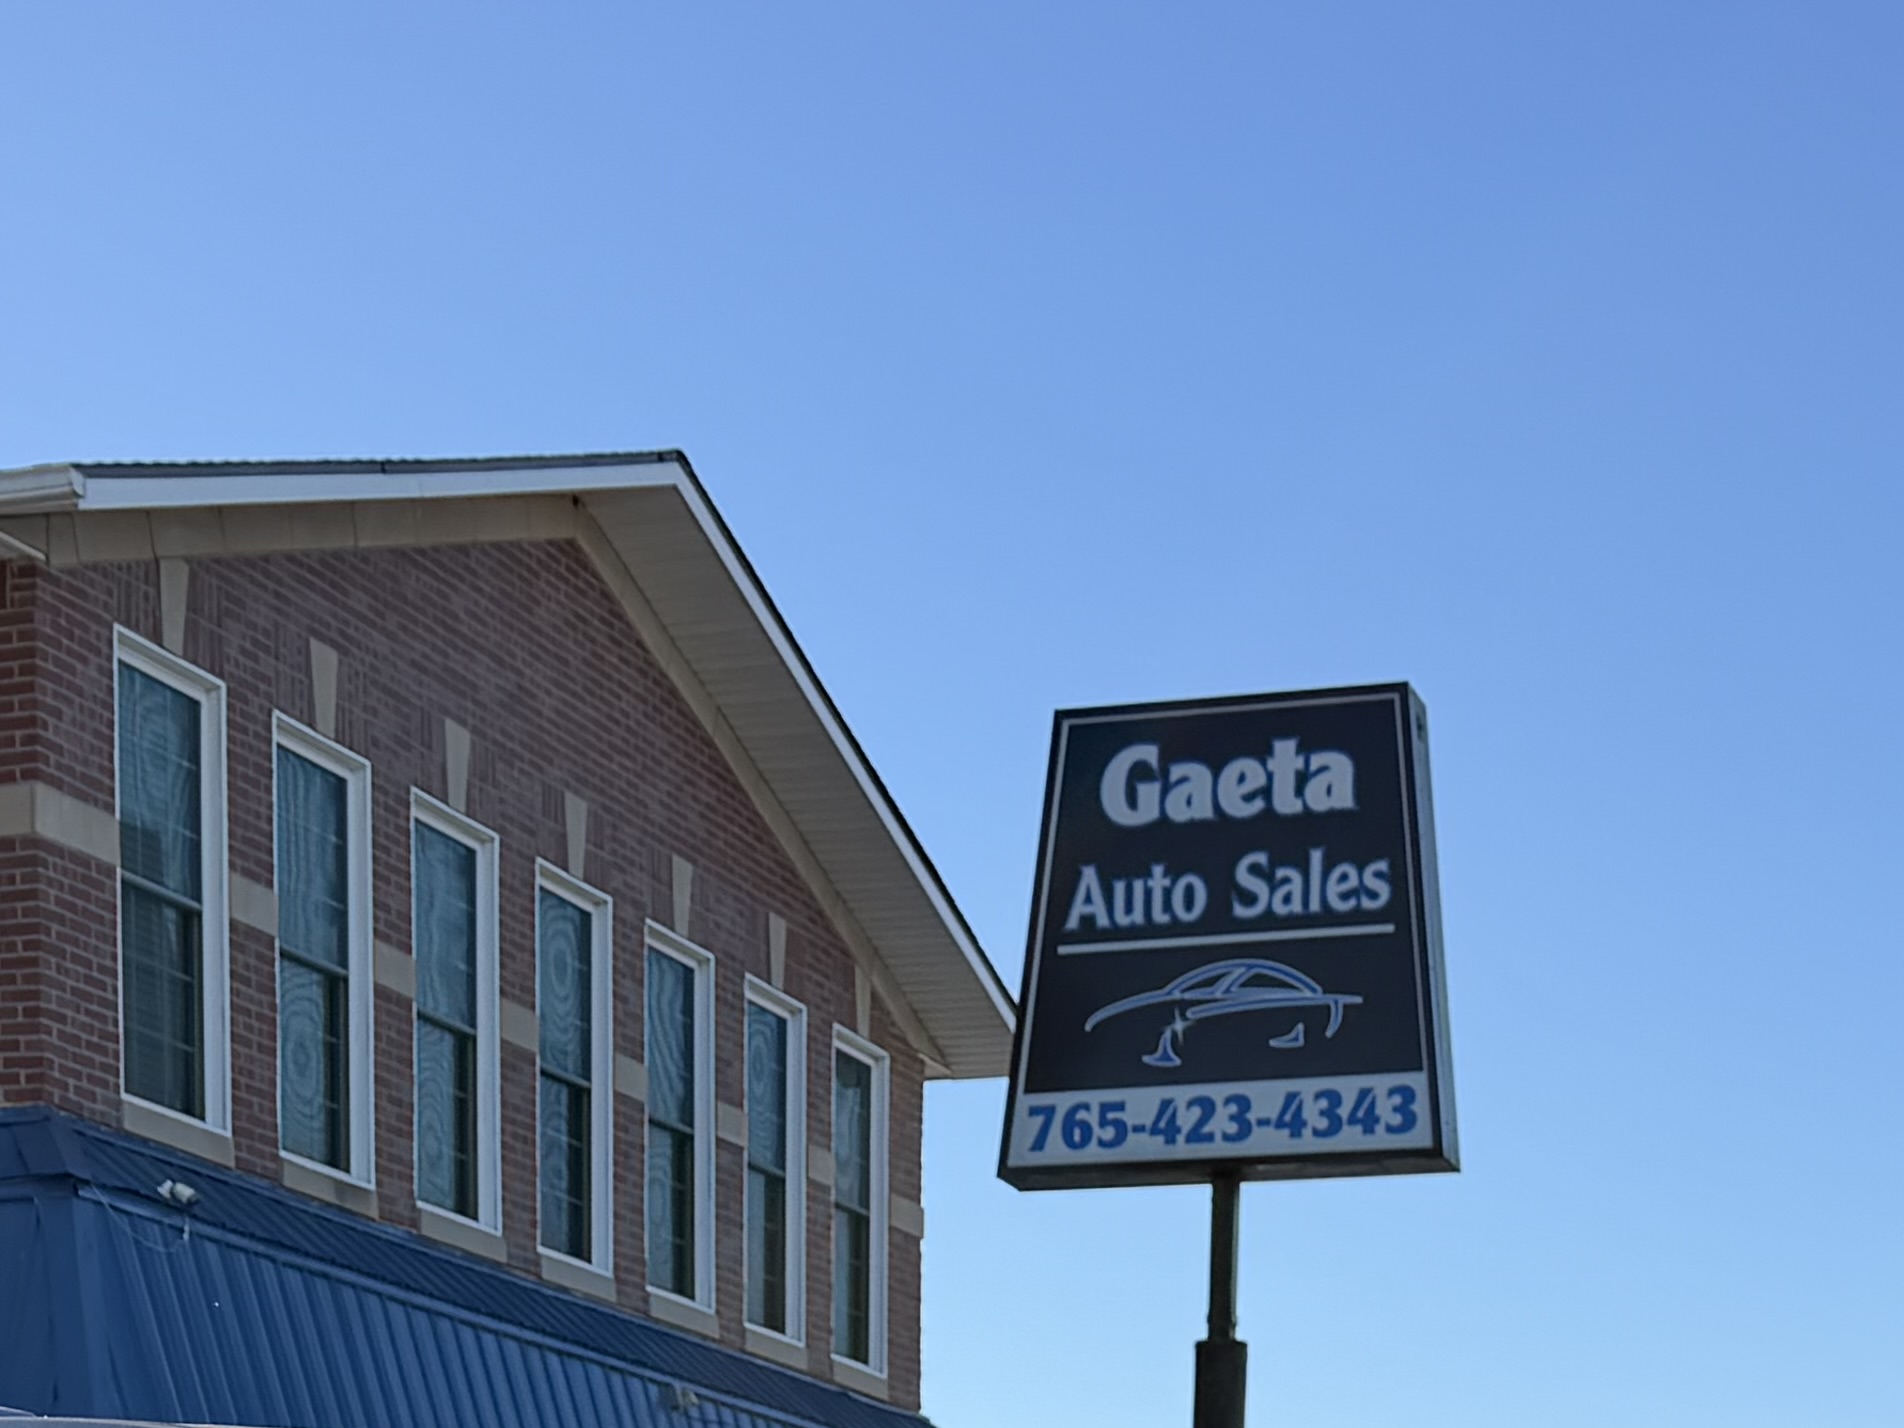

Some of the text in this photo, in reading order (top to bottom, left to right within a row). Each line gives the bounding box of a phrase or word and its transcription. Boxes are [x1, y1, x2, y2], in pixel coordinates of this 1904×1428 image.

[1100, 738, 1355, 827] Gaeta
[1061, 847, 1393, 932] Auto Sales
[1027, 1084, 1418, 1153] 765-423-4343
